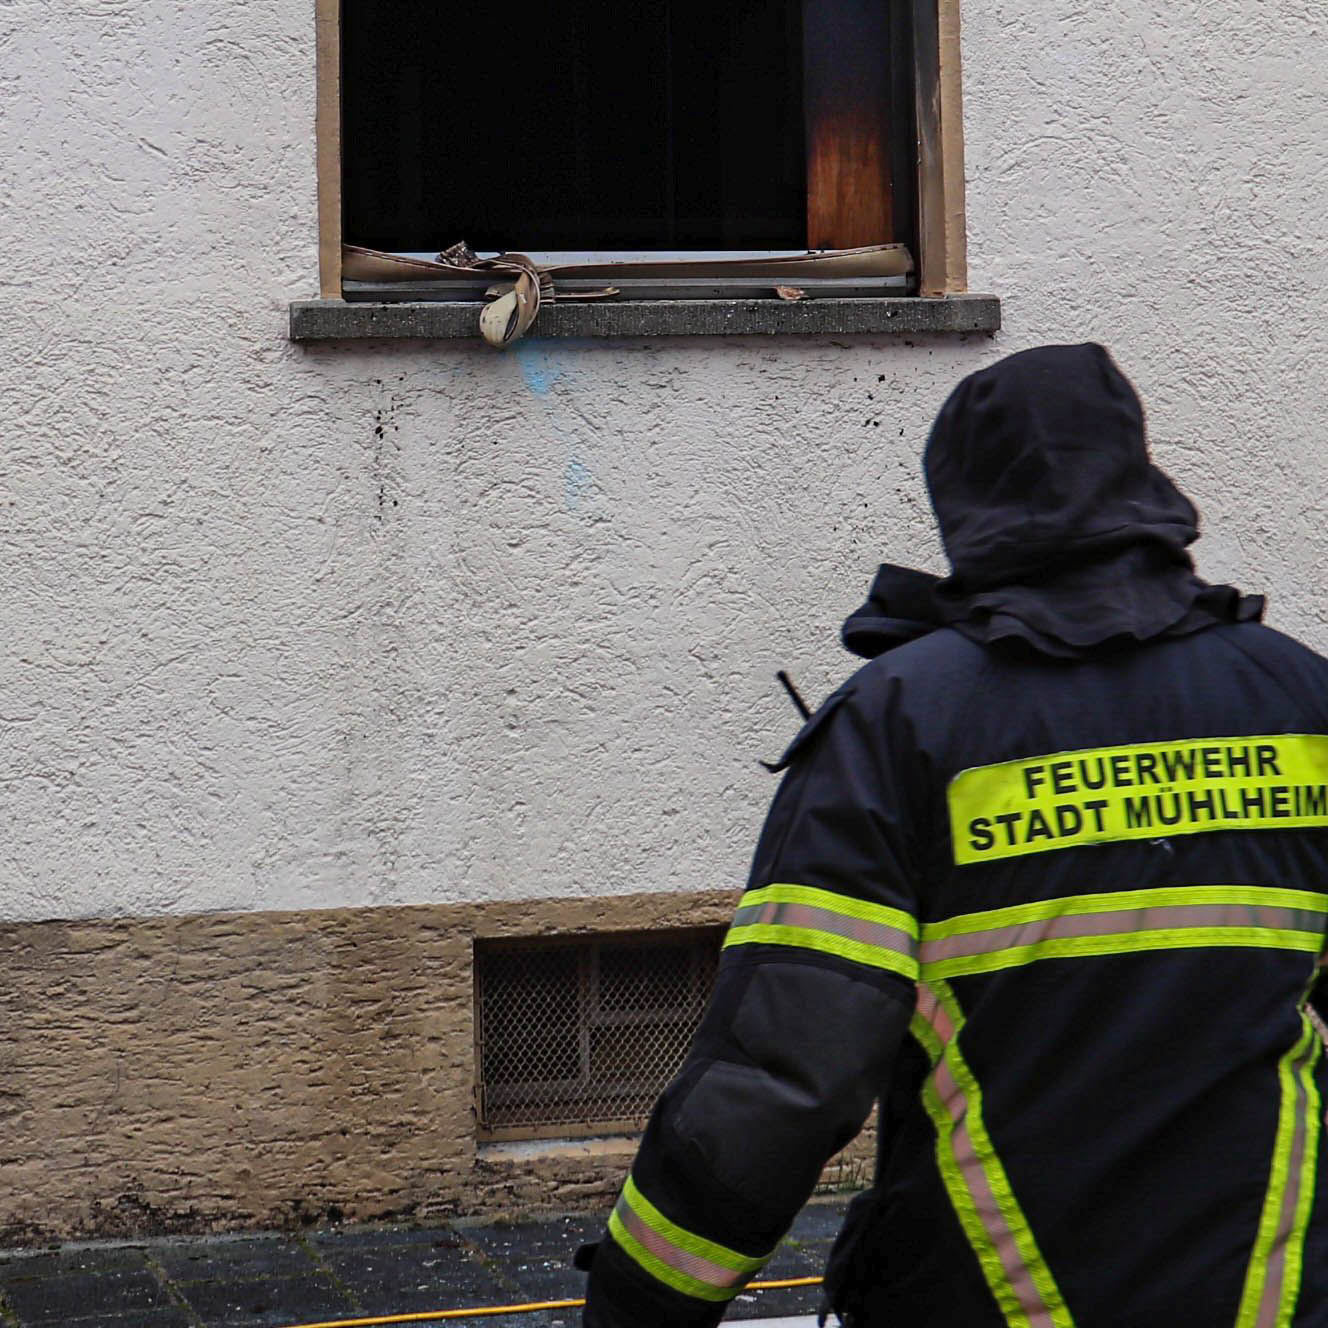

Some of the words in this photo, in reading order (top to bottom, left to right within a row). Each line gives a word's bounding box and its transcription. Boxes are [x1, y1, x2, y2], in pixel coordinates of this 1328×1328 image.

[1024, 745, 1284, 800] FEUERWEHR
[969, 799, 1111, 852] STADT
[1125, 785, 1328, 830] MÜHLHEIM
